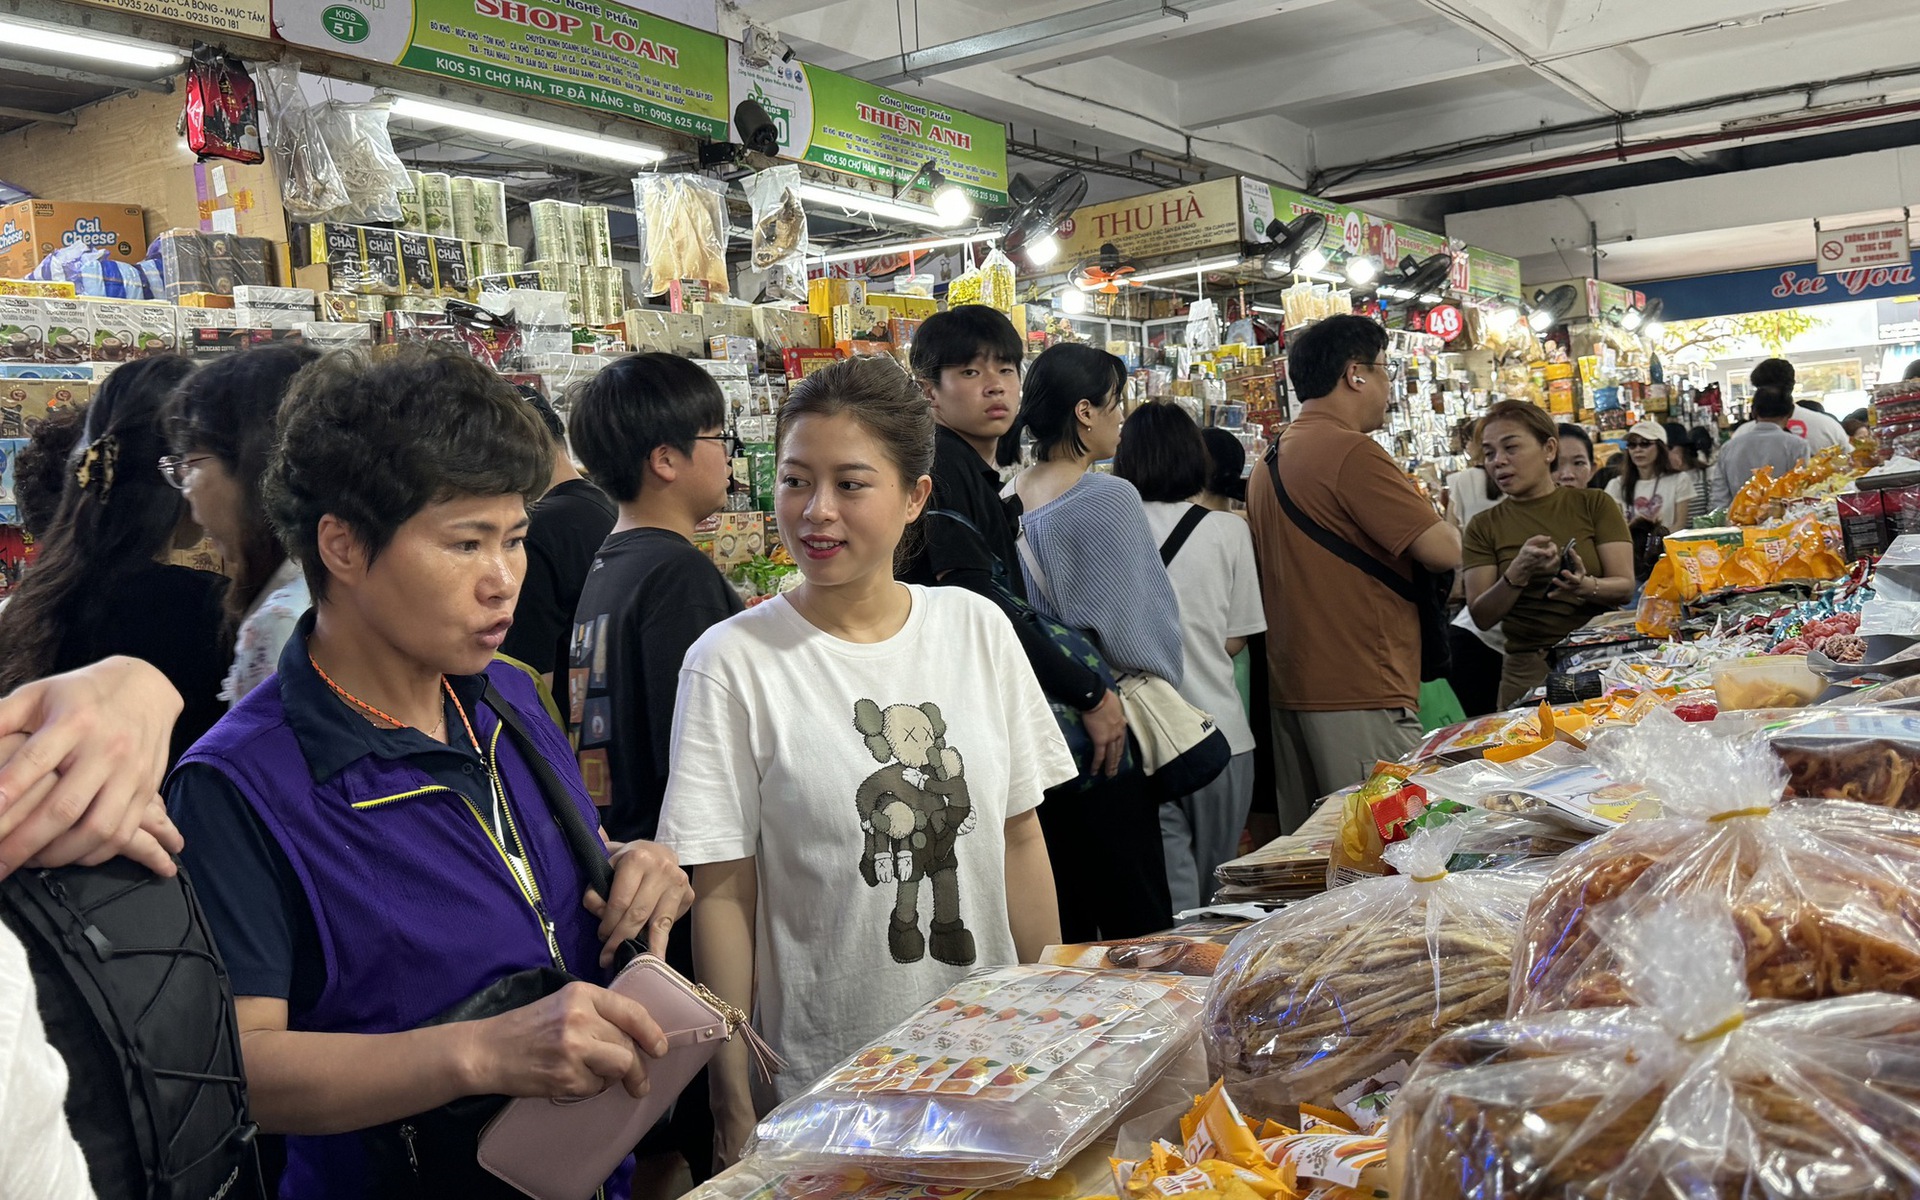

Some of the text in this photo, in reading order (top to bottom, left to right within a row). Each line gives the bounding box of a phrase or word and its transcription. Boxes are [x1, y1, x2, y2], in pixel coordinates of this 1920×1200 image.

[143, 2, 159, 13] 261
[162, 6, 179, 17] 403
[186, 11, 208, 23] 0935
[211, 15, 226, 27] 190
[228, 19, 239, 29] 181
[335, 9, 356, 22] KIOS
[333, 23, 355, 38] 51
[474, 0, 679, 67] SHOP LOAN
[436, 57, 465, 74] KIOS
[469, 65, 481, 78] 51
[485, 70, 511, 87] CHỢ
[515, 74, 545, 94] HÀN,
[650, 108, 672, 123] 0905
[674, 116, 692, 128] 625
[878, 94, 902, 109] CÔNG
[928, 125, 972, 150] ANH
[823, 152, 838, 164] KIOS
[838, 156, 847, 168] 50
[1092, 203, 1154, 239] THU
[1162, 190, 1204, 226] HÀ
[3, 219, 16, 236] Cal
[75, 217, 101, 232] Cal
[1058, 217, 1073, 233] 49
[61, 230, 117, 247] Cheese
[329, 236, 358, 249] CHAT
[1345, 221, 1360, 249] 49
[369, 239, 393, 252] CHAT
[402, 244, 426, 256] CHAT
[1381, 227, 1397, 262] 48
[437, 248, 461, 260] CHAT
[1863, 252, 1899, 262] SMOKING
[1772, 266, 1915, 297] See You
[1430, 308, 1458, 335] 48
